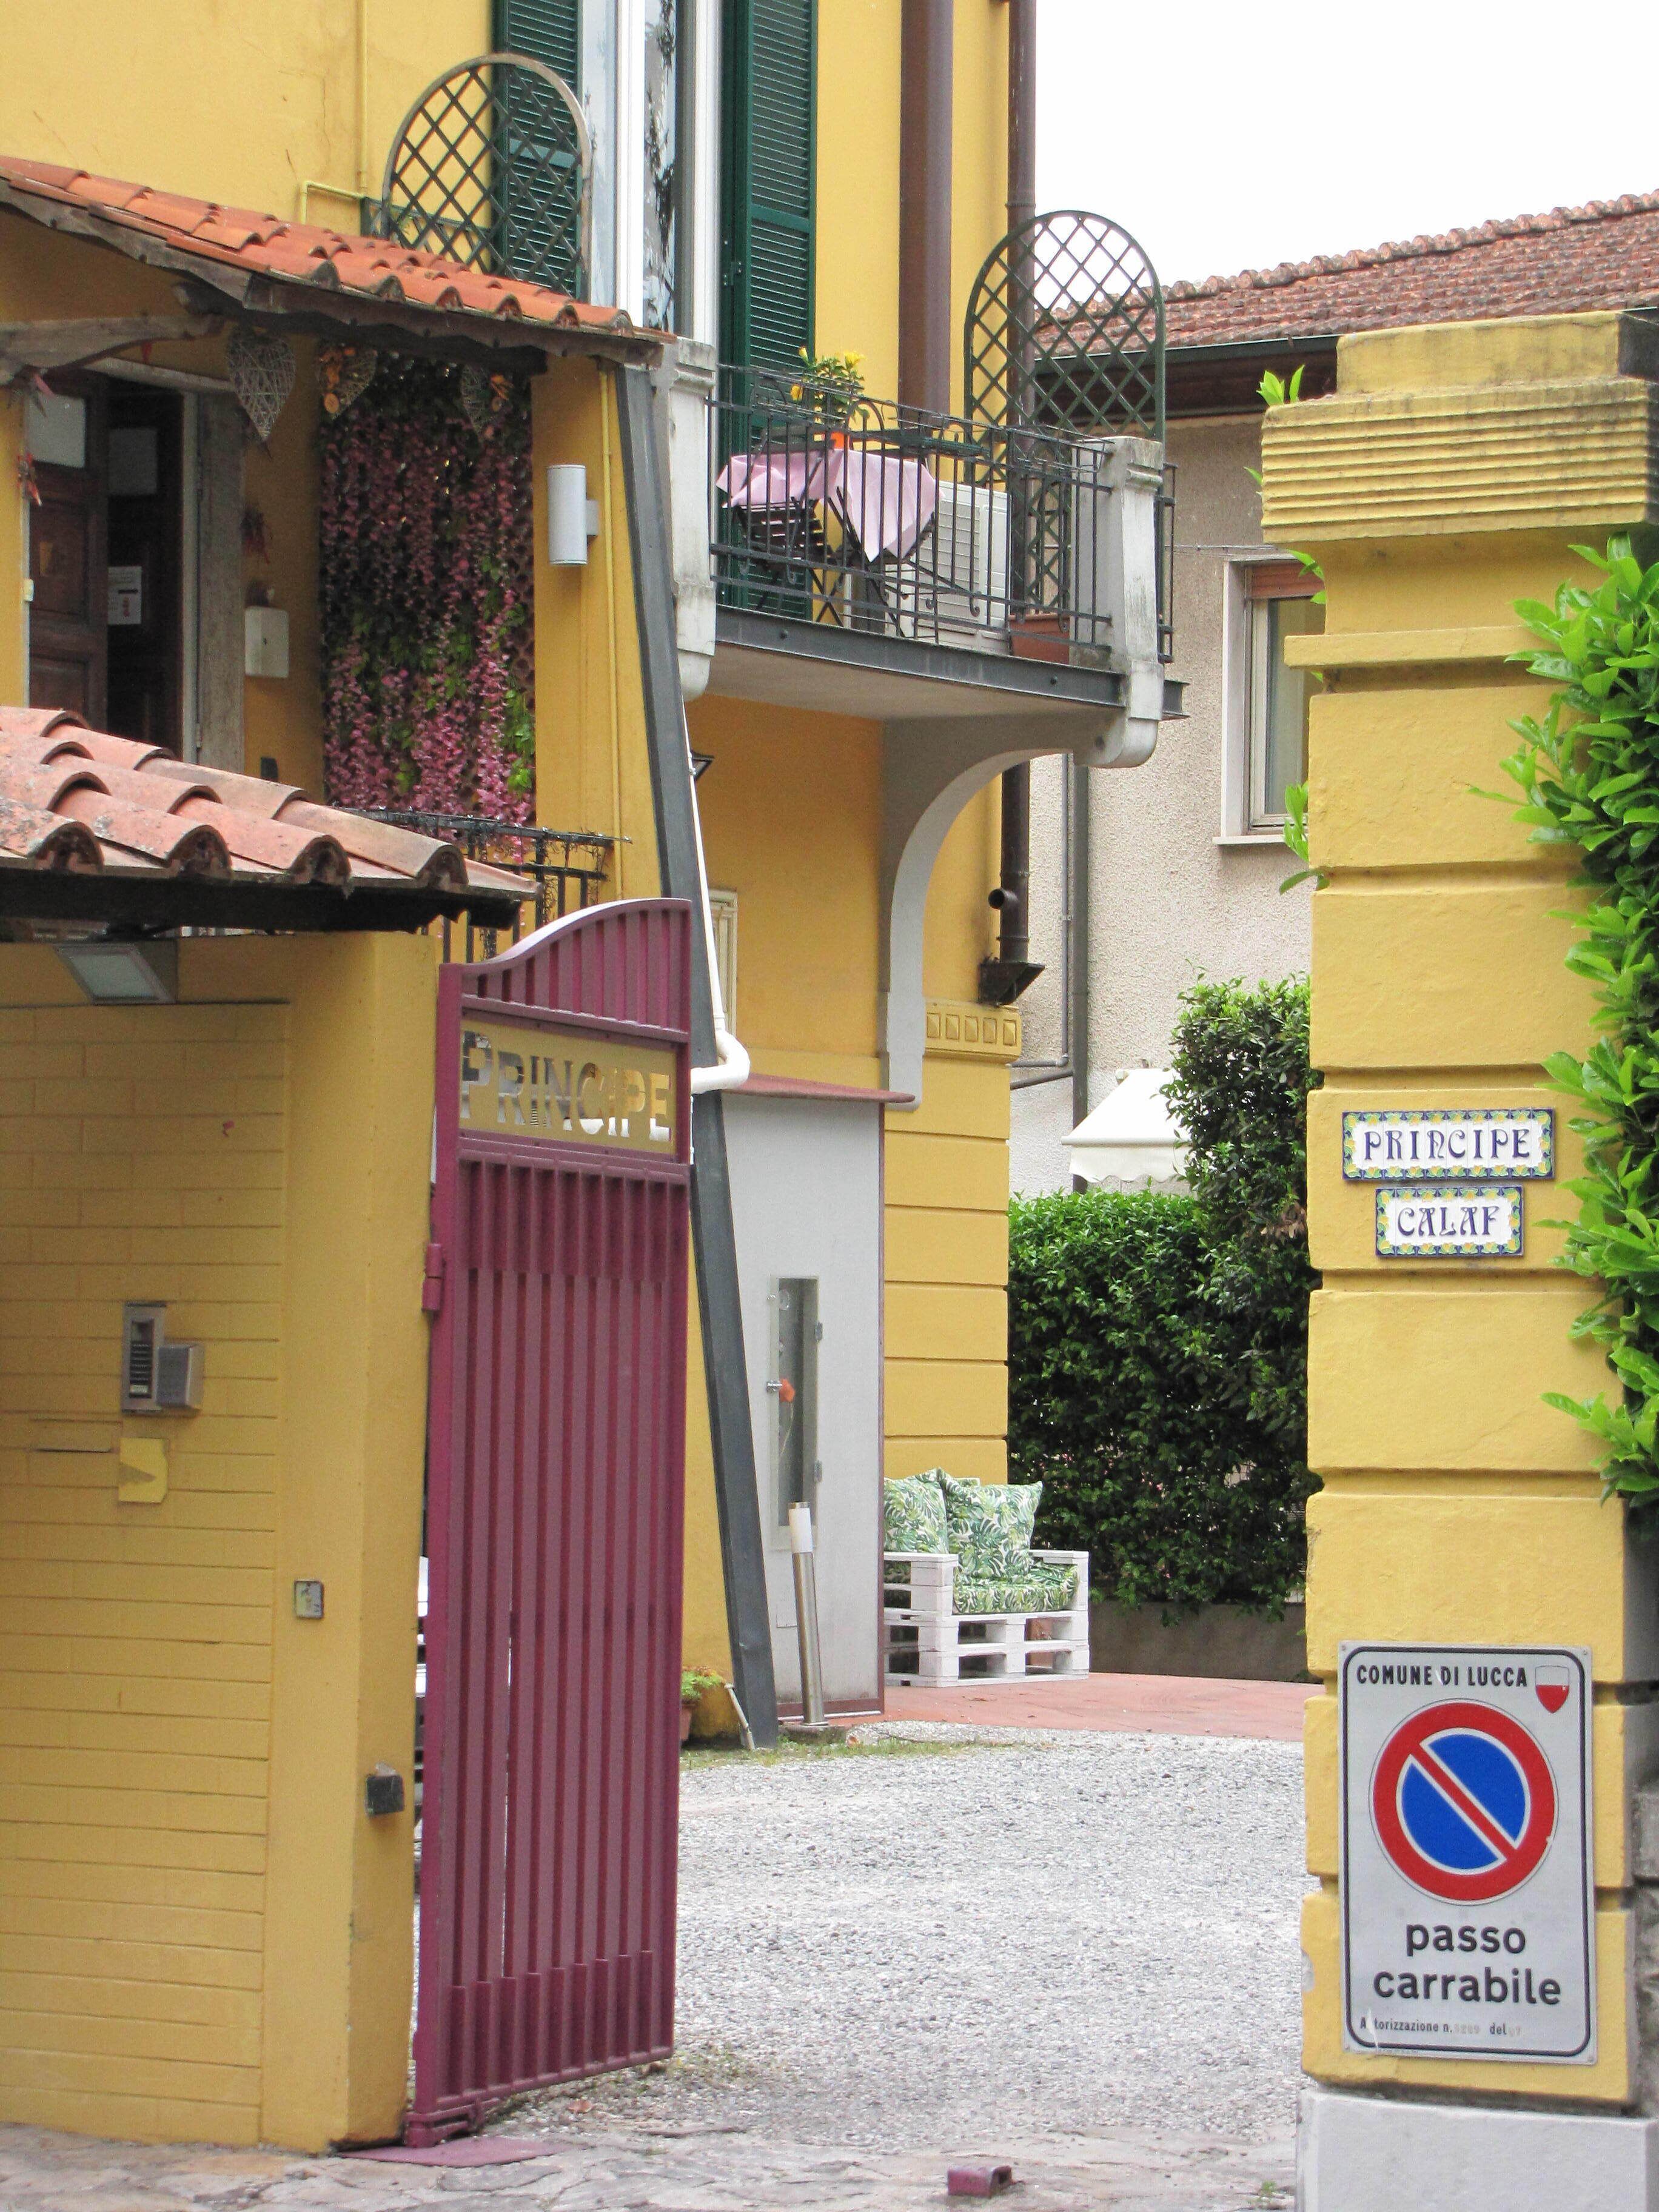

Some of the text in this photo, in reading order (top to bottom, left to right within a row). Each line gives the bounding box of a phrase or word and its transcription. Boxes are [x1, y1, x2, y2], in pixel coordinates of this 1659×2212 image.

[461, 1031, 671, 1141] PRINCIPE
[1364, 1128, 1530, 1161] PRINCIPE
[1398, 1206, 1499, 1236] CALAF
[1356, 1665, 1527, 1686] COMUNE DI LUCCA
[1406, 1923, 1526, 1957] passo
[1373, 1967, 1562, 2005] carrabile
[1360, 2017, 1439, 2033] Atorizzazione
[1443, 2023, 1453, 2033] n.
[1490, 2023, 1507, 2036] del
